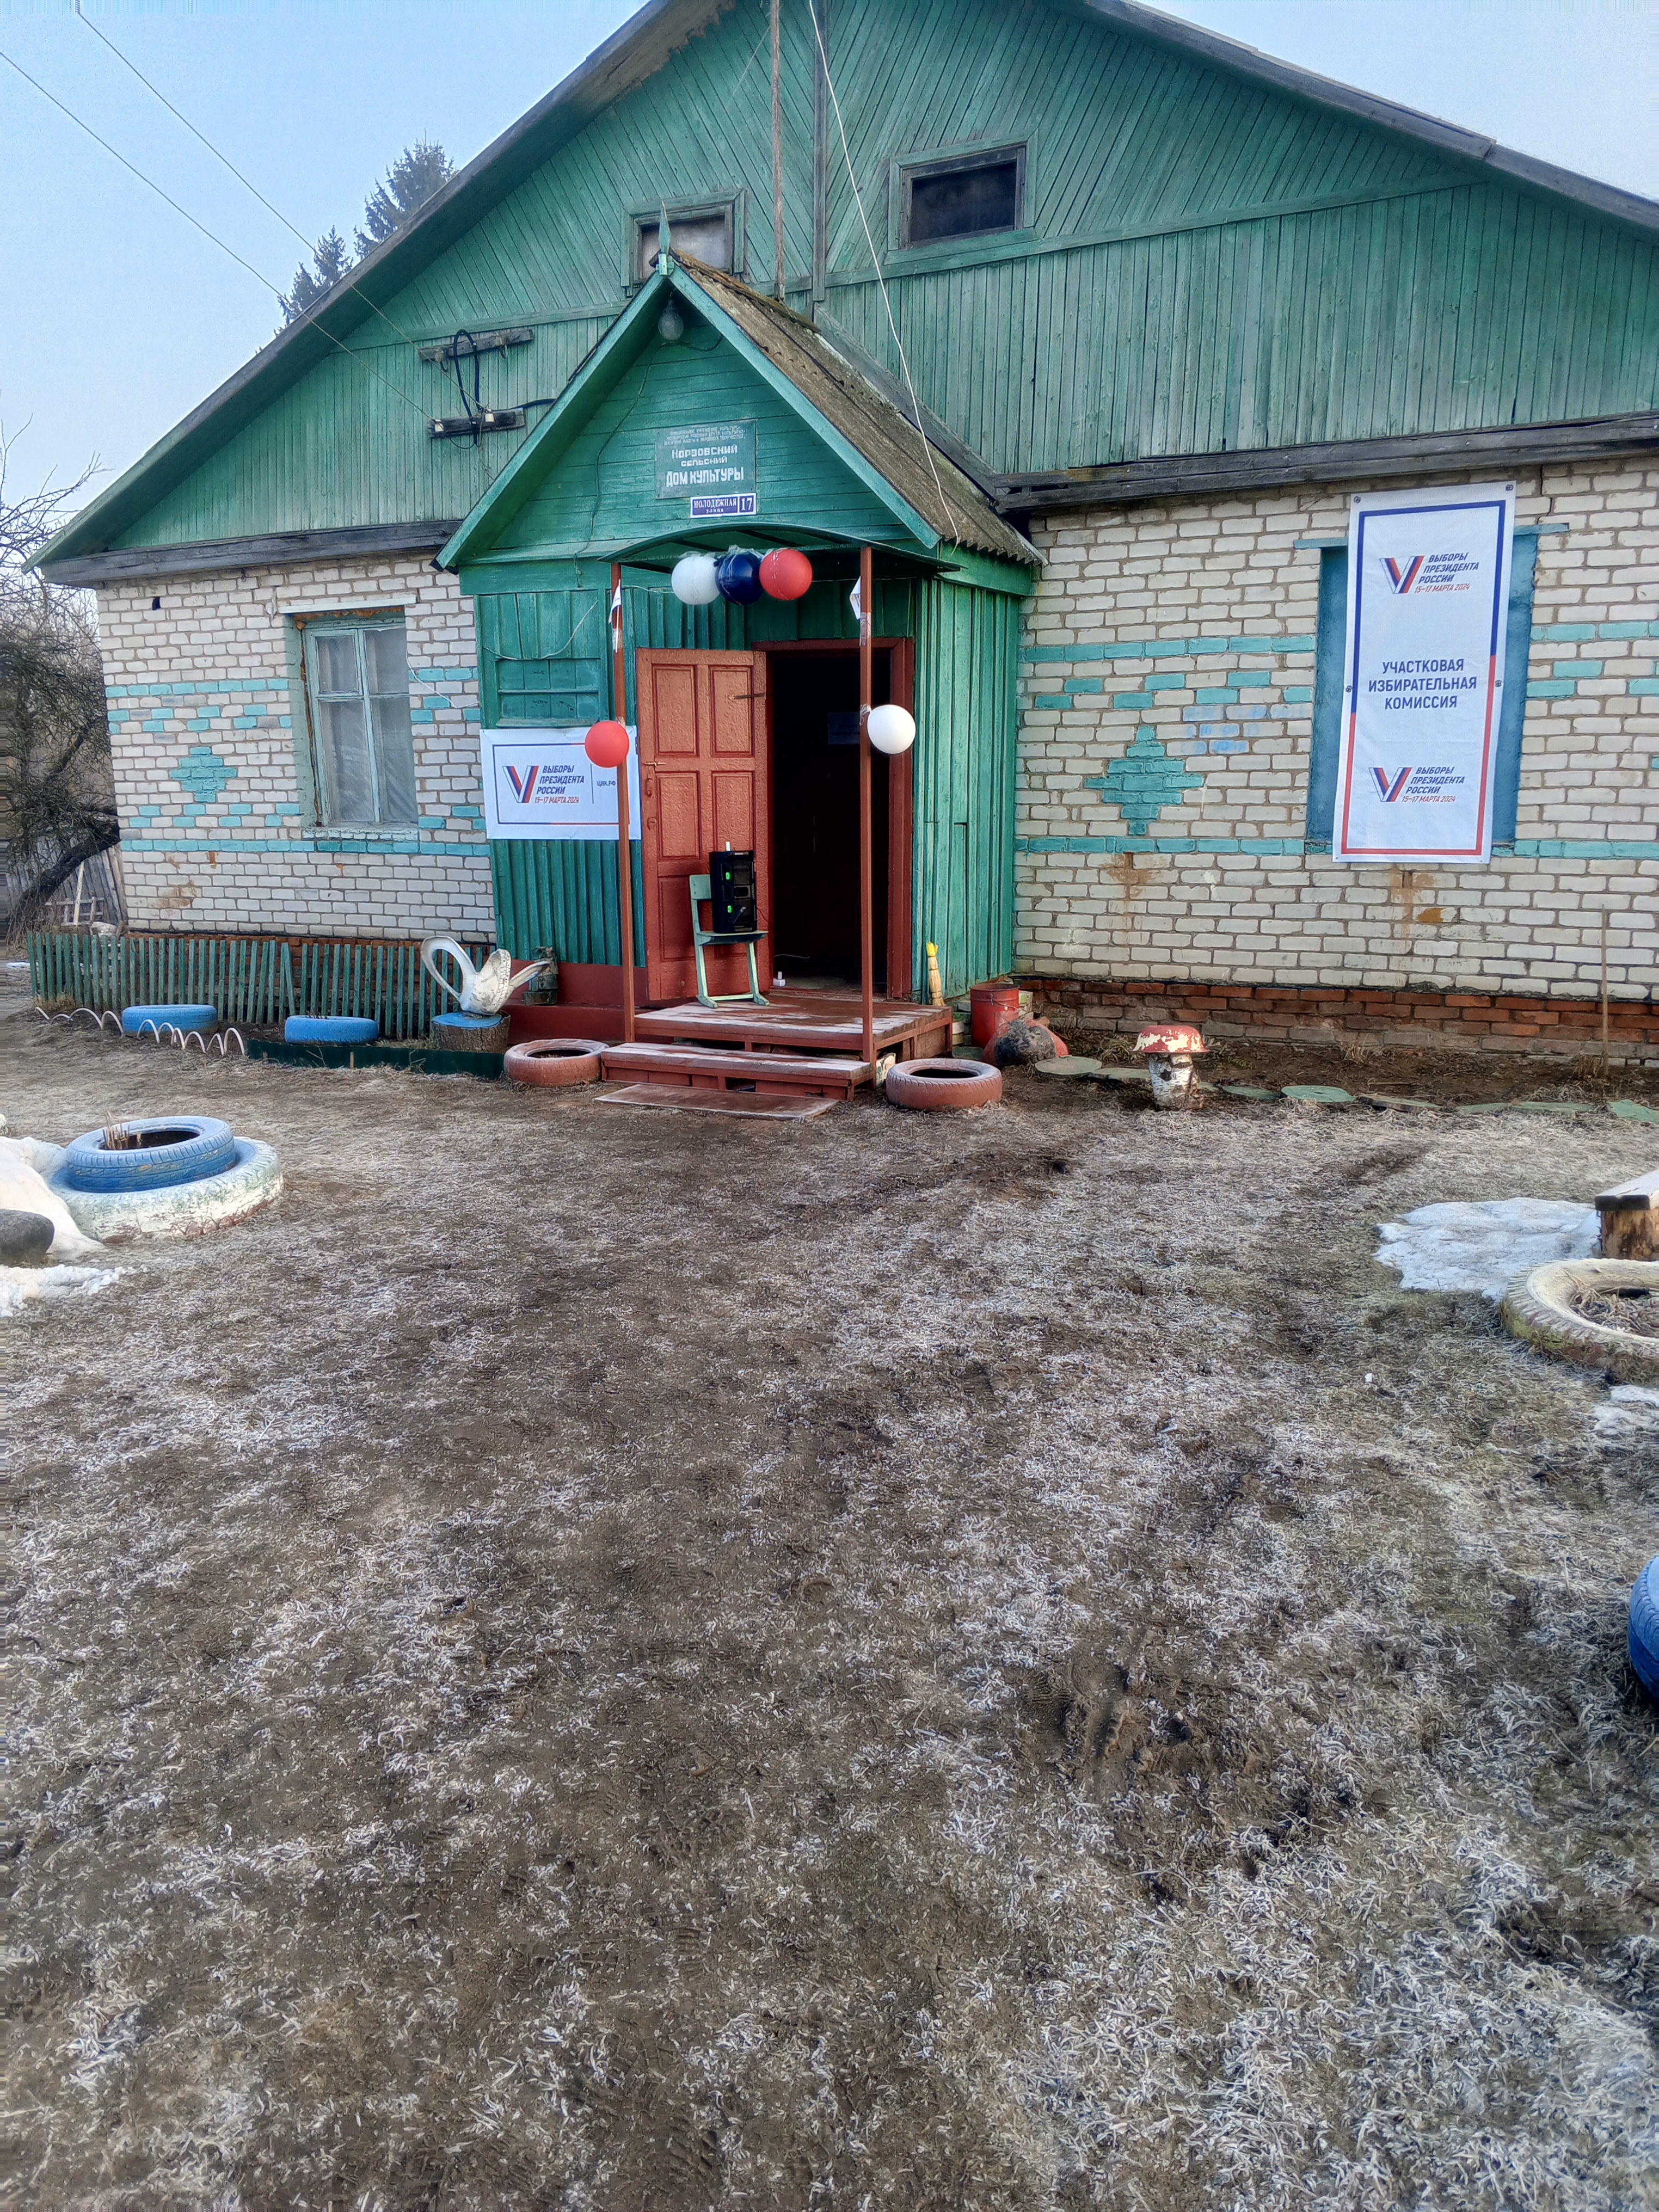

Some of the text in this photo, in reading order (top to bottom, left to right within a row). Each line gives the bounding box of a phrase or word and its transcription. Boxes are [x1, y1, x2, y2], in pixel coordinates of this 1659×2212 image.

[666, 466, 744, 487] ДОМ КУЛЬТУРЫ
[741, 497, 753, 511] 17
[1428, 552, 1469, 563] ВЫБОРЫ
[1423, 562, 1479, 574] ПРЕЗИДЕНТА
[1418, 574, 1455, 584] РОССИИ
[1432, 584, 1454, 592] МАРТА
[1454, 583, 1471, 591] 2024
[1382, 659, 1464, 674] УЧАСТКОВАЯ
[1368, 677, 1477, 692] ИЗБИРАТЕЛЬНАЯ
[1385, 696, 1458, 710] КОМИССИЯ
[542, 765, 575, 773] ВЫБОРЫ
[1415, 766, 1455, 775] ВЫБОРЫ
[539, 775, 585, 785] ПРЕЗИДЕНТА
[1410, 776, 1465, 785] ПРЕЗИДЕНТА
[537, 786, 566, 795] РОССИИ
